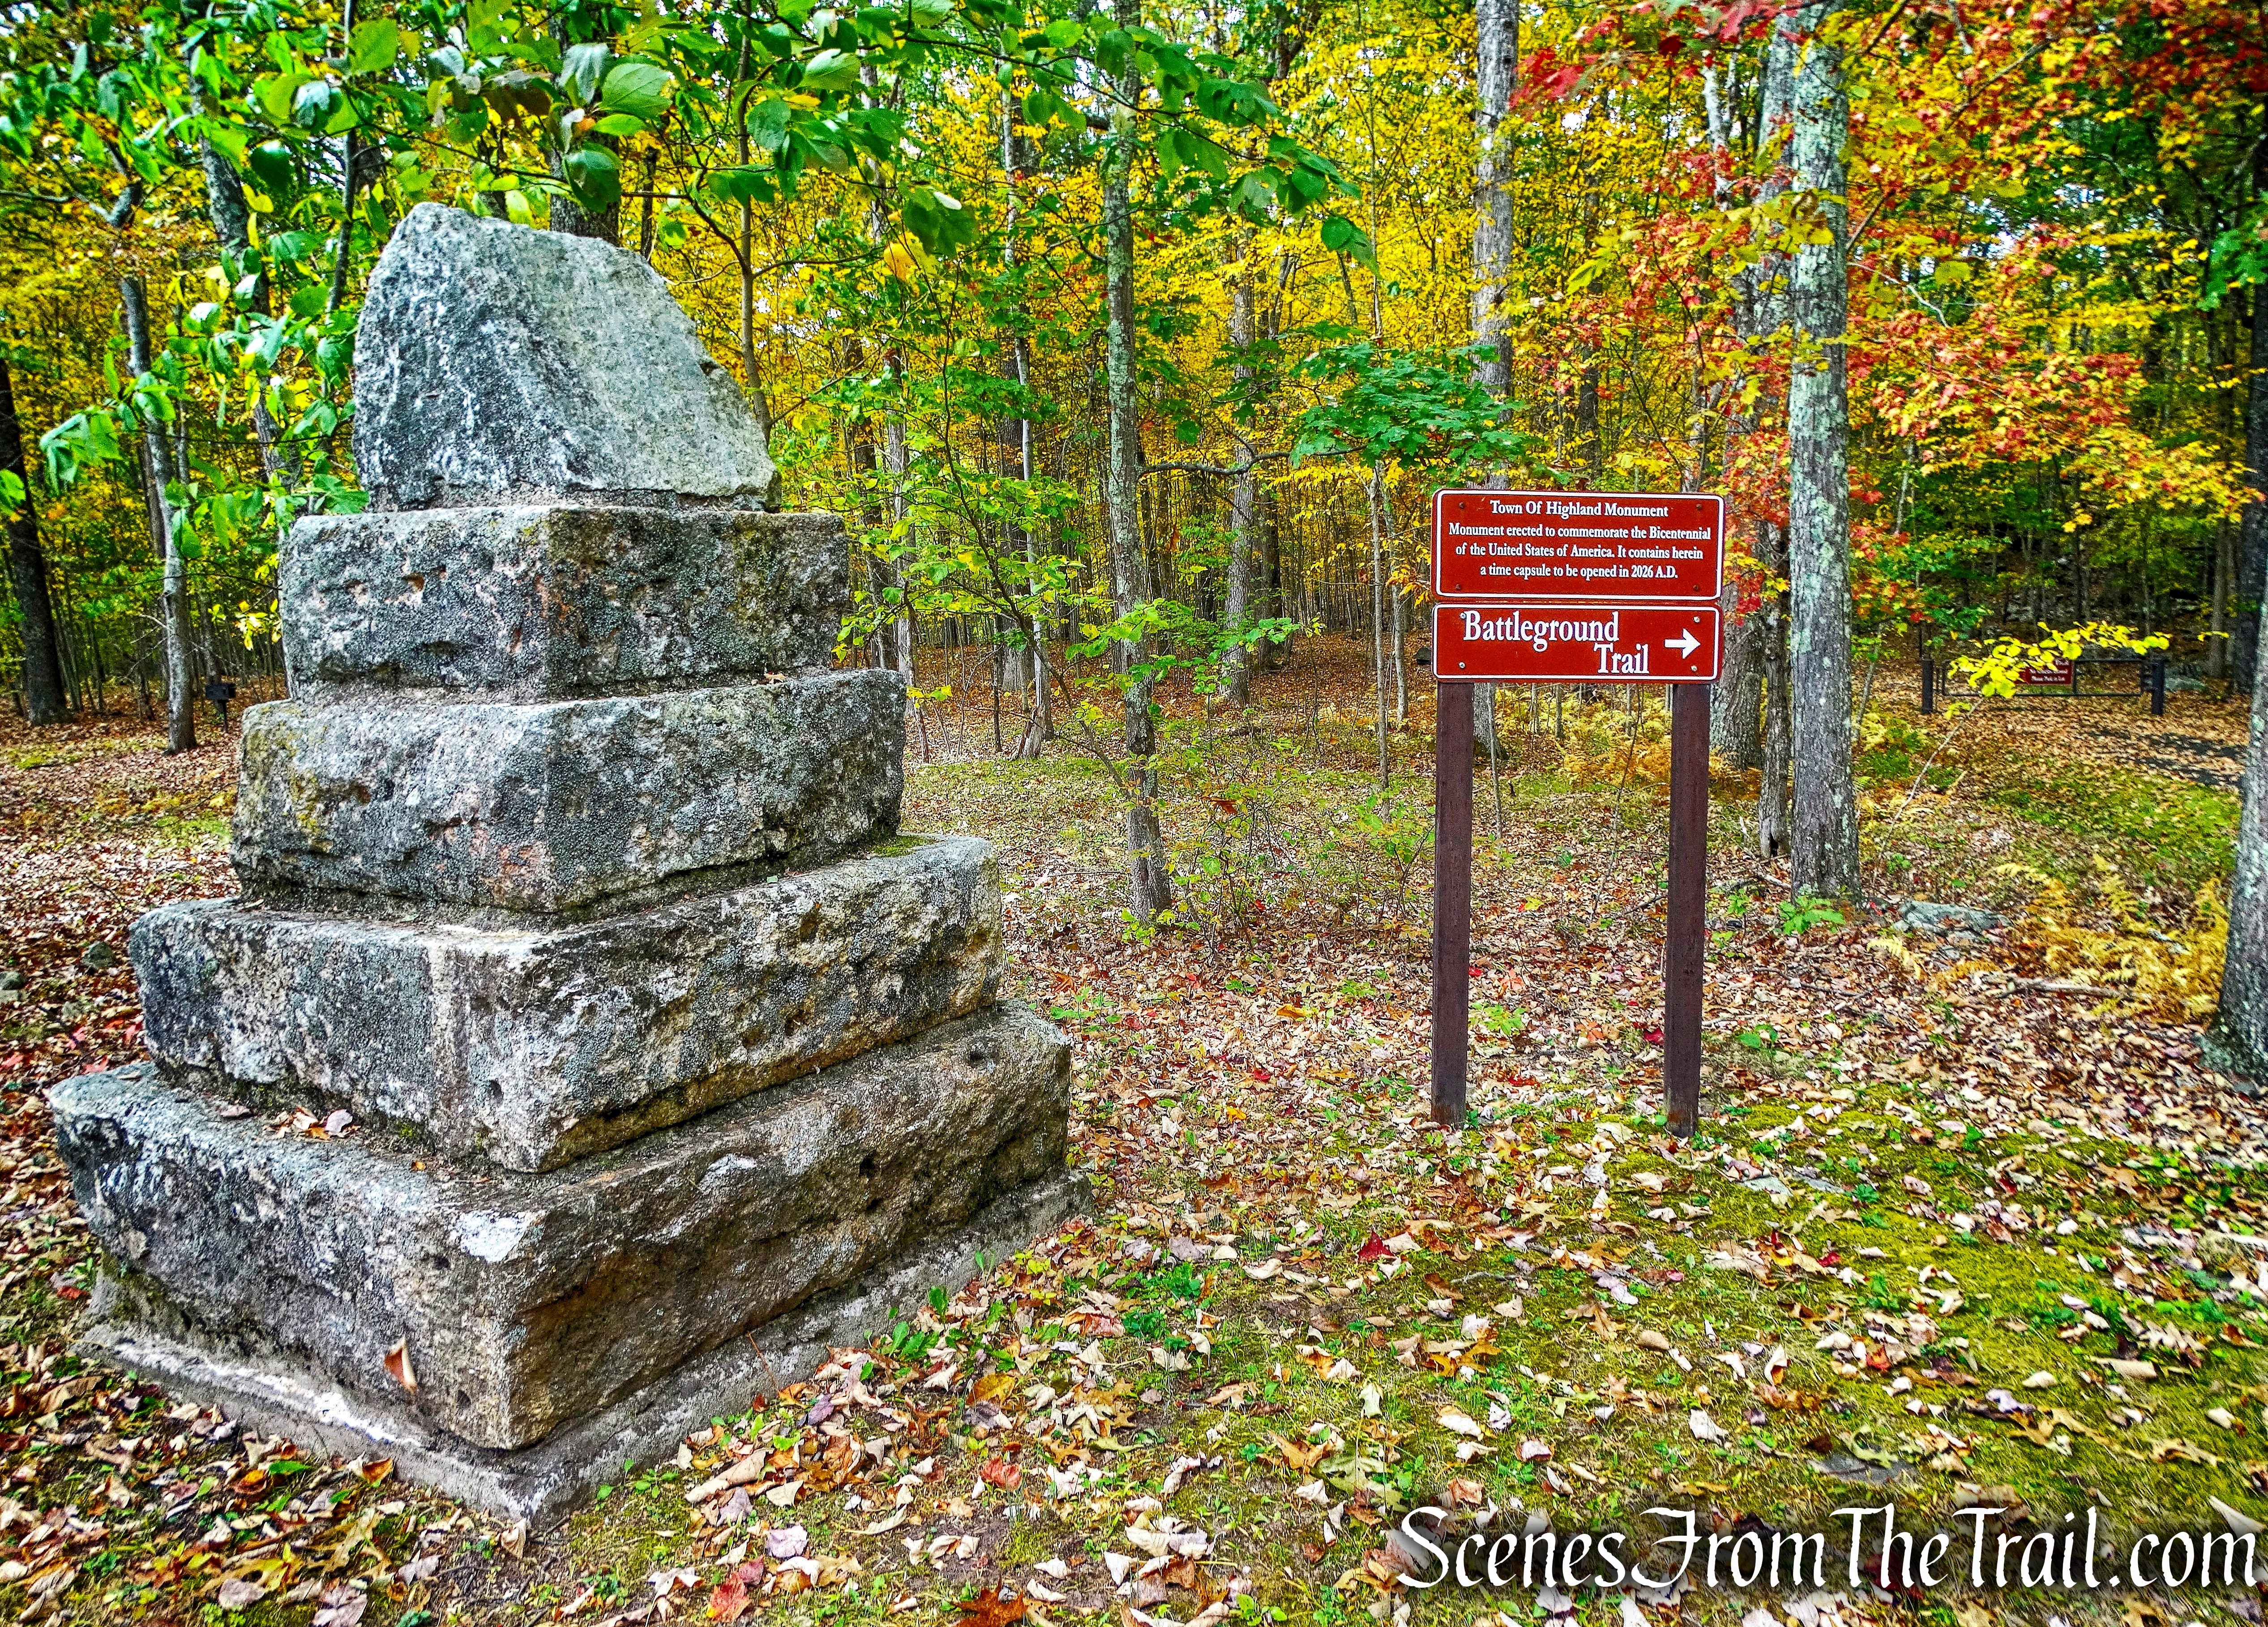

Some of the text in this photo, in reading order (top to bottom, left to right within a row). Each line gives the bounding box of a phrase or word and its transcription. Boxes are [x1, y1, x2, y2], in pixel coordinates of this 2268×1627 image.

[1489, 500, 1669, 520] Town Of Highland Monument
[1449, 522, 1711, 540] Monument erected to commemorate the Bicentennial
[1455, 542, 1703, 559] of the United States of America. It contains herein
[1480, 562, 1678, 581] a time capsule to be opened in 2026 A.D.
[1463, 610, 1620, 652] Battleground
[1593, 642, 1650, 674] Trail
